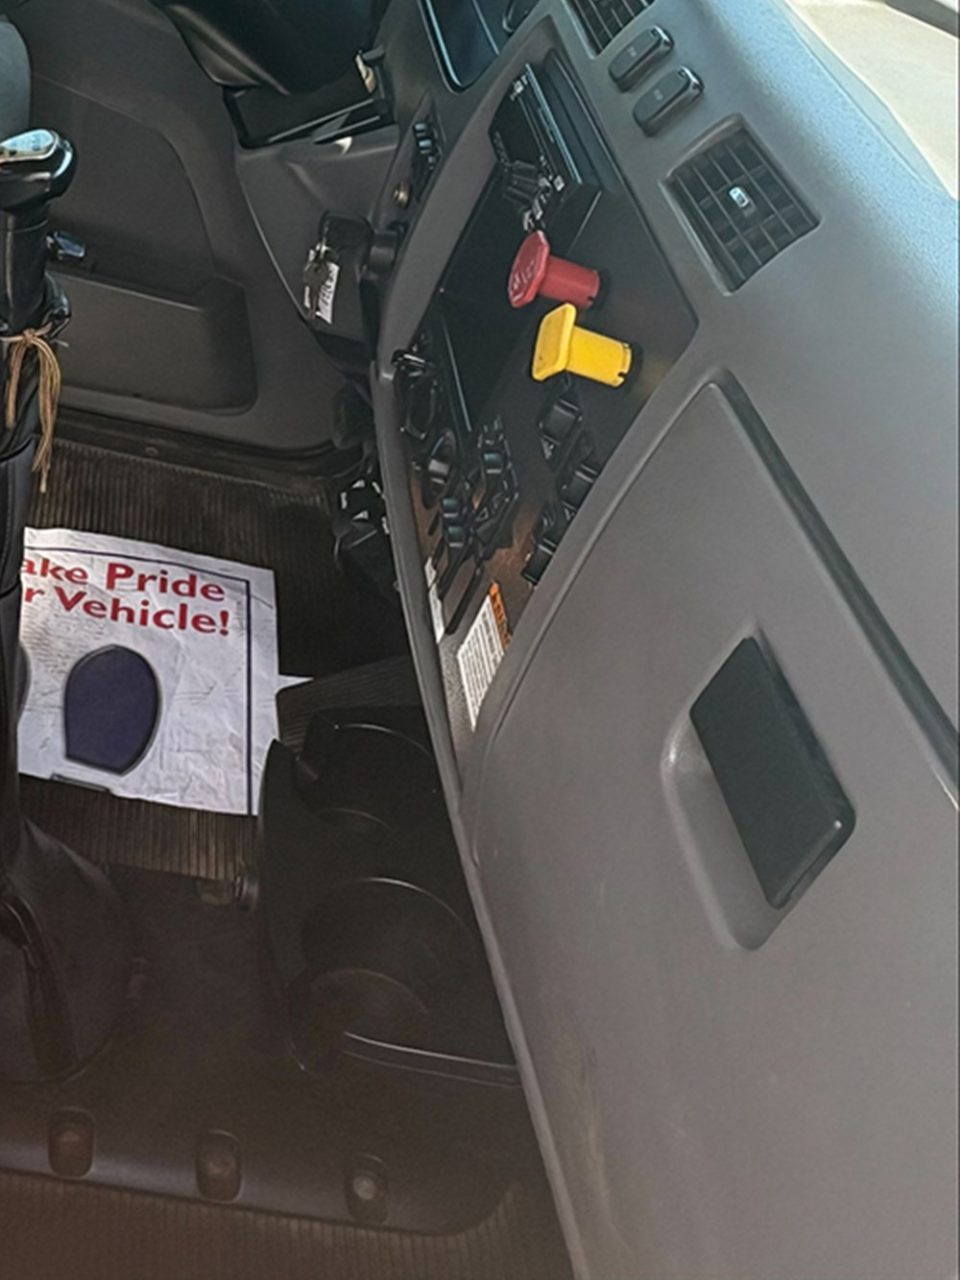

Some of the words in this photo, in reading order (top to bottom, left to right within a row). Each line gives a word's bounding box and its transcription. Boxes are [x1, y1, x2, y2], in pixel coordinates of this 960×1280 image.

[20, 557, 89, 585] ake
[106, 562, 226, 602] Pride
[54, 585, 230, 637] Vehicle!
